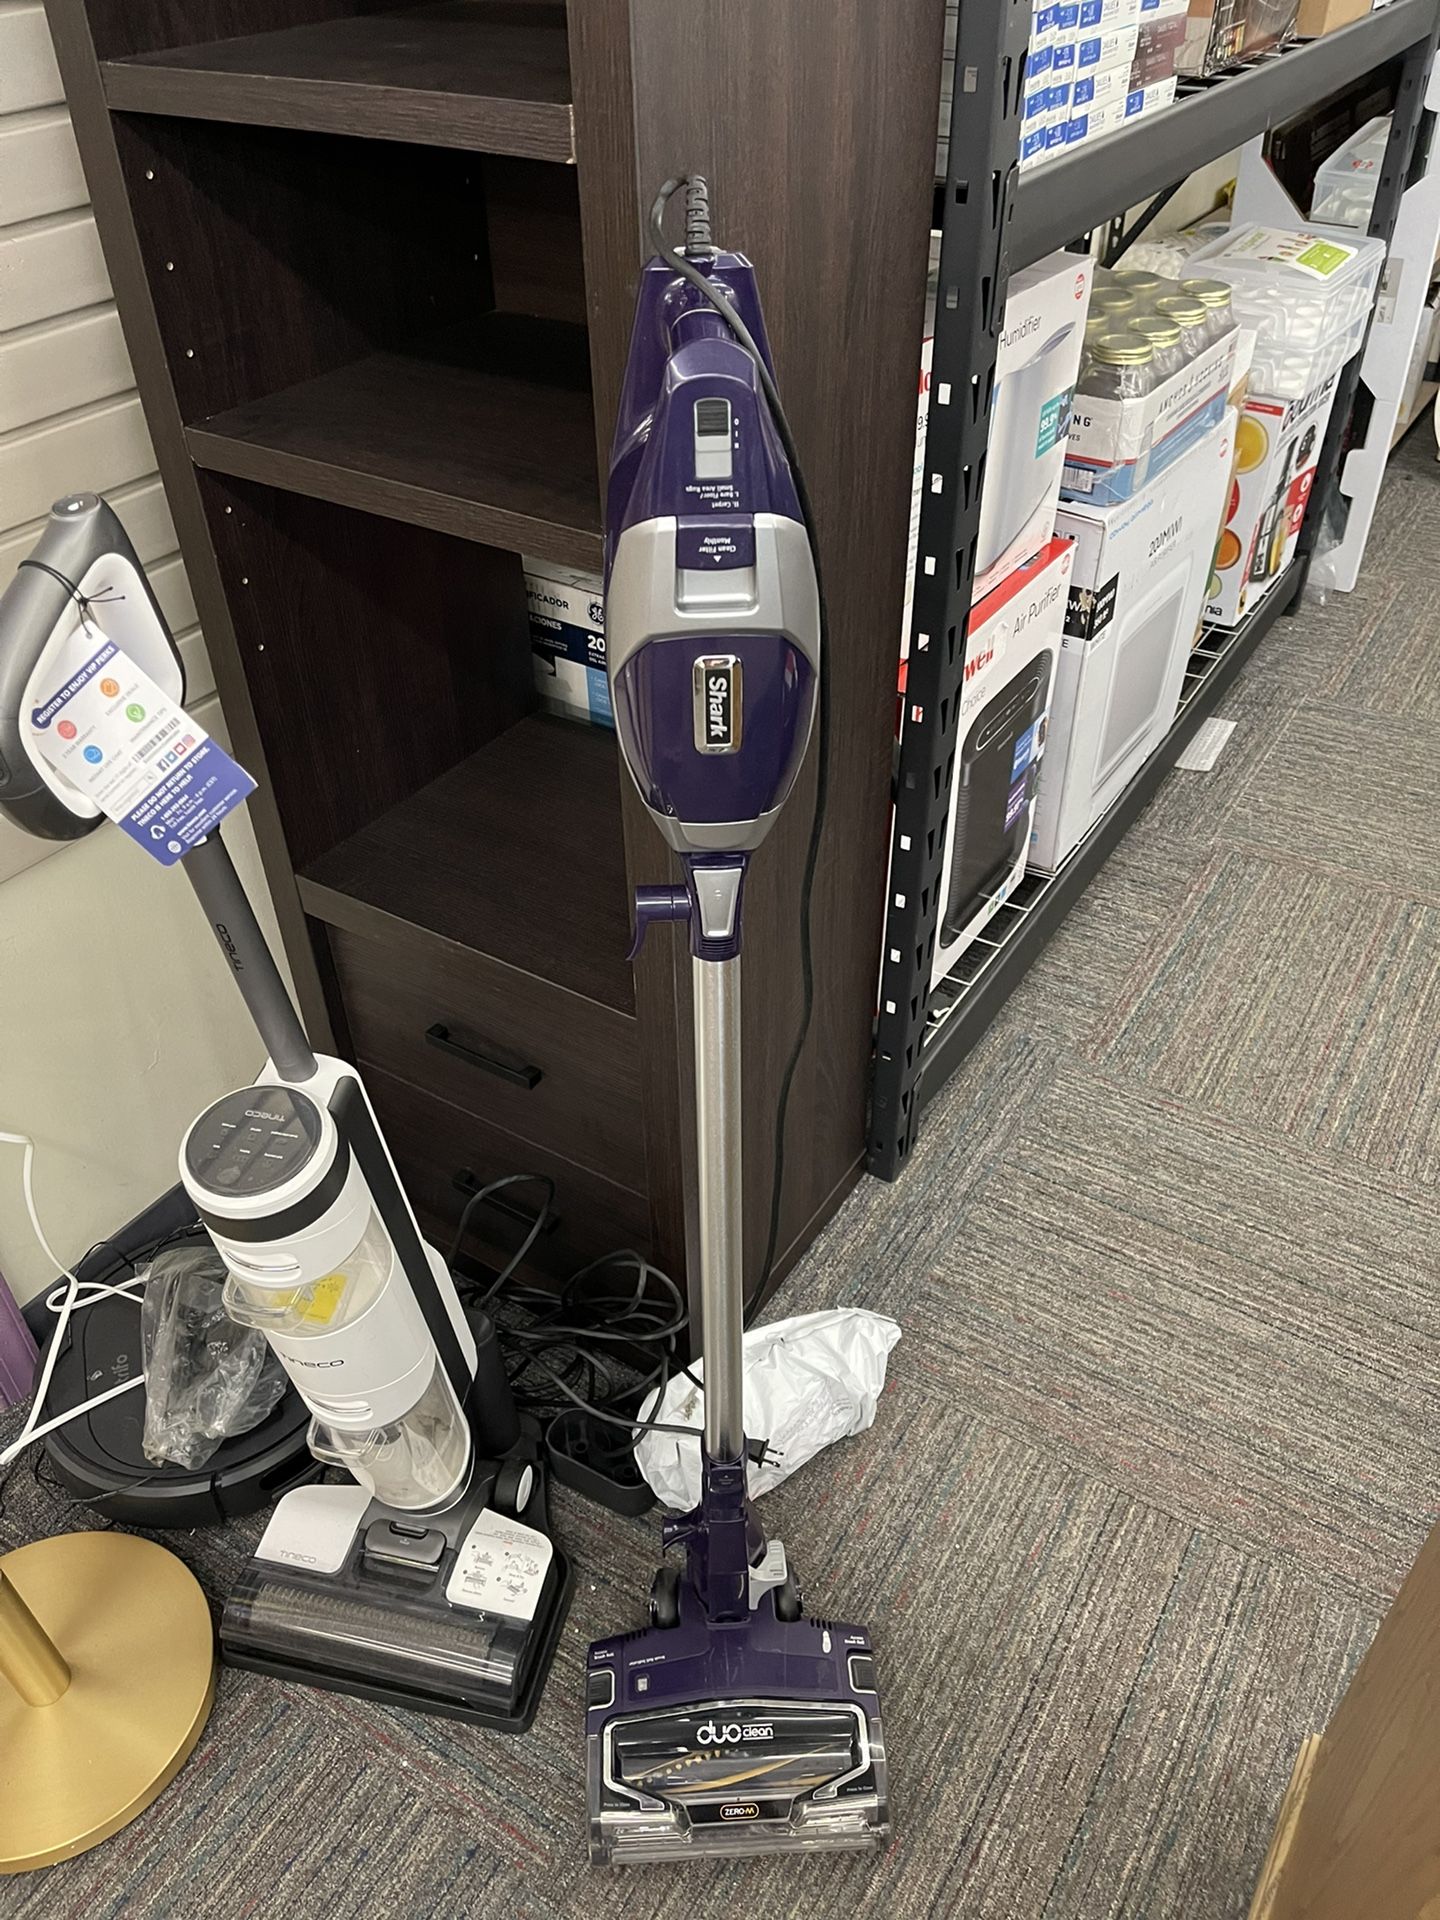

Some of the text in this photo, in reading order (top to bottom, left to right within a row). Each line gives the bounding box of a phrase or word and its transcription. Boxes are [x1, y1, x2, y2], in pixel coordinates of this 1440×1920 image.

[1000, 315, 1041, 348] Humidifier
[685, 485, 700, 493] Rugs
[712, 500, 731, 509] Carpet
[1012, 612, 1028, 637] Air
[1028, 584, 1062, 623] Purifier
[587, 634, 606, 652] 20
[37, 646, 116, 724] REGISTER TO ENJOY VIP PERKS
[708, 676, 728, 738] Shark
[131, 802, 151, 822] PLEASE
[148, 795, 158, 806] DO
[156, 785, 169, 799] NOT
[166, 768, 187, 789] RETURN
[184, 761, 194, 772] TO
[137, 807, 158, 828] TINECO
[159, 792, 174, 808] HERE
[171, 785, 181, 796] TO
[696, 1720, 774, 1744] duo clean
